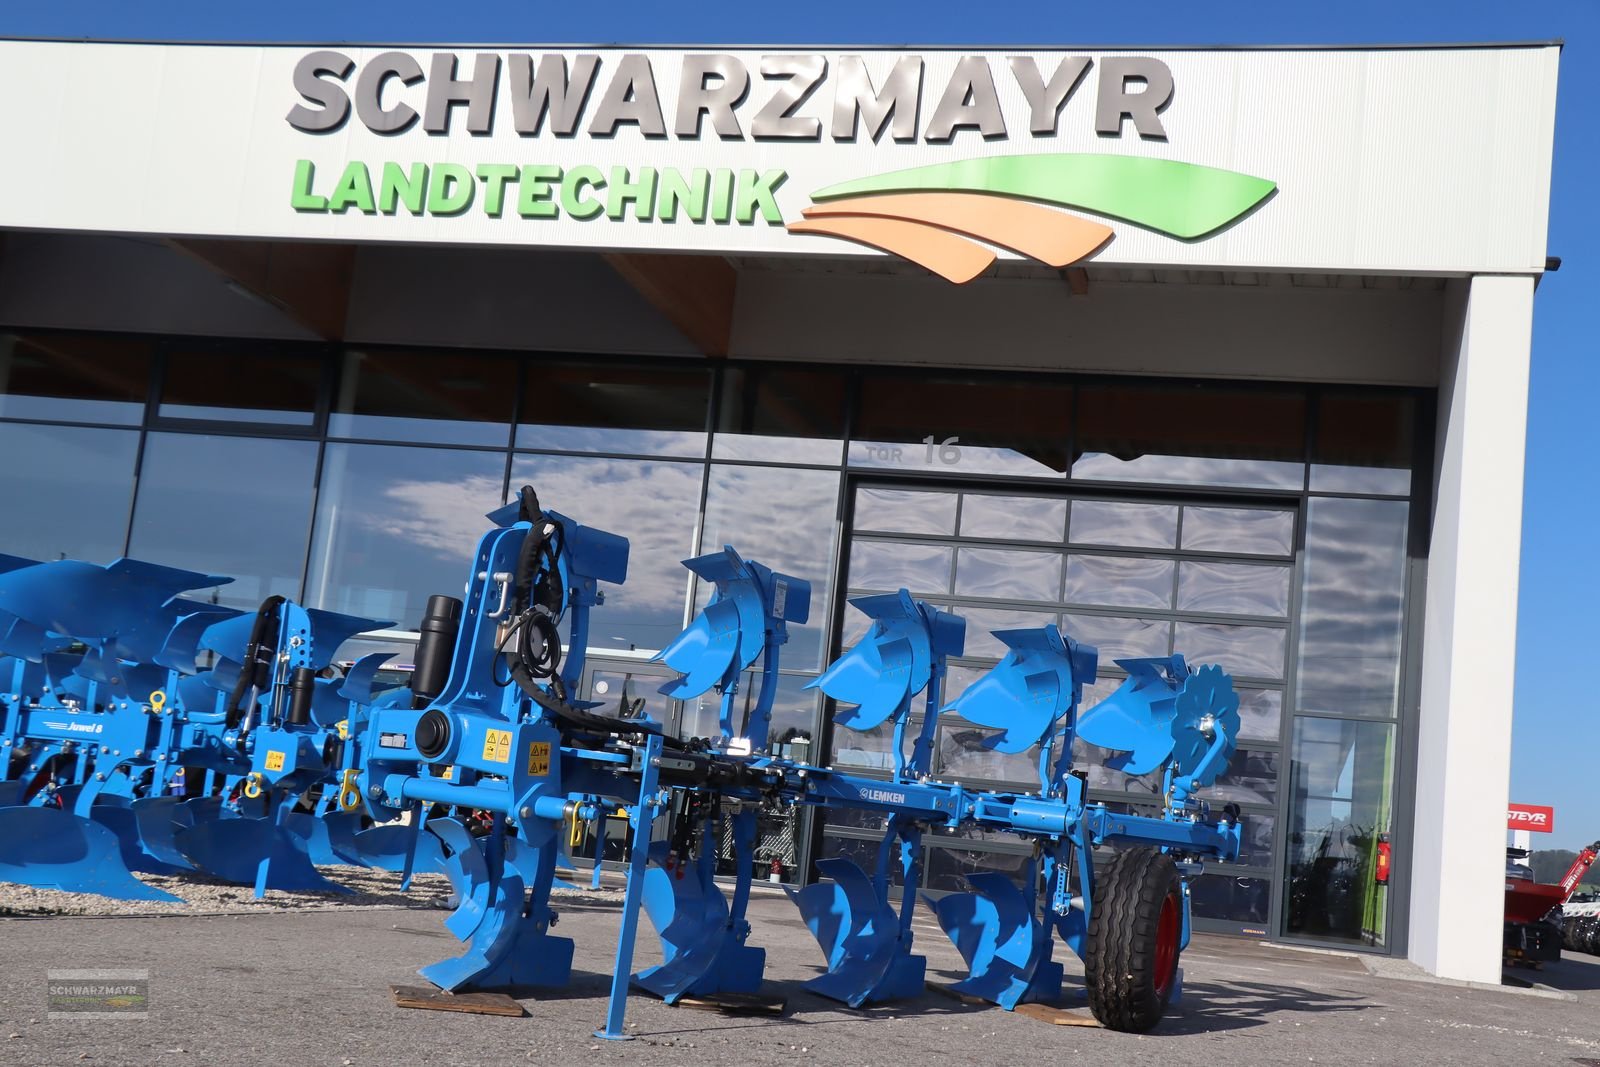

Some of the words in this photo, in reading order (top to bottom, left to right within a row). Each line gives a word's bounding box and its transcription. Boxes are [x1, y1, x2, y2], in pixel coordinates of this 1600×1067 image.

[286, 50, 1174, 144] SCHWARZMAYR
[291, 159, 788, 226] LANDTECHNIK
[865, 446, 903, 463] TOR
[922, 434, 962, 465] 16
[67, 721, 96, 733] Juwel
[868, 789, 905, 804] LEMKEN
